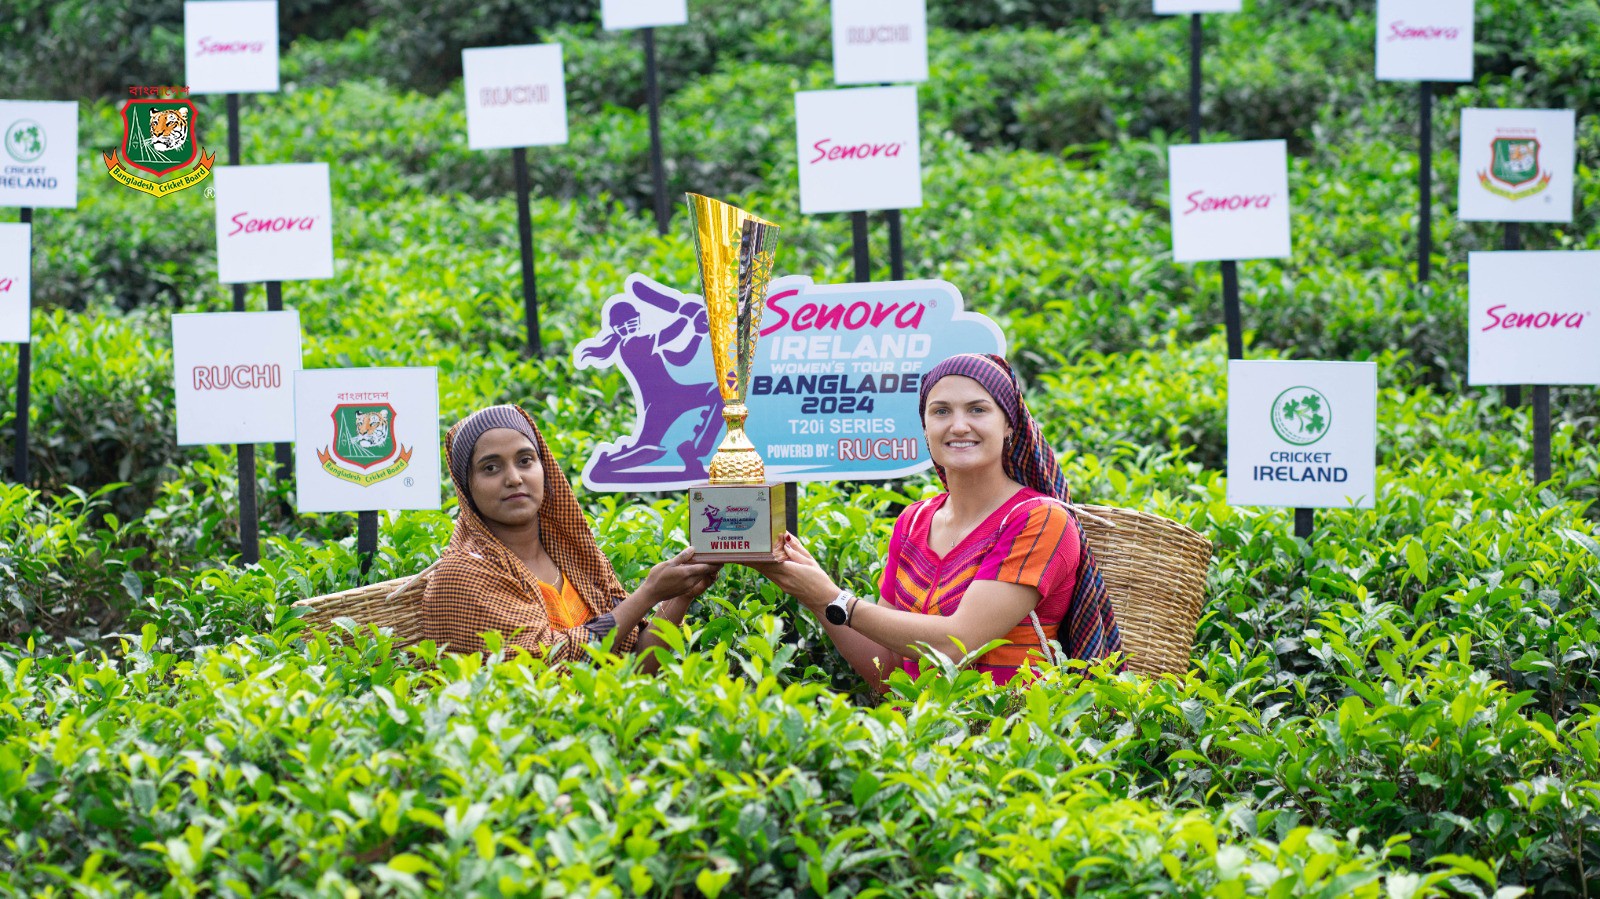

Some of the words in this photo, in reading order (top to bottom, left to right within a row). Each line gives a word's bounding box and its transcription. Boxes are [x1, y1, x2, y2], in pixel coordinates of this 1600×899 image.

[1386, 20, 1459, 41] Senora
[196, 36, 264, 57] Senora
[810, 138, 901, 164] Senora
[1183, 190, 1270, 215] Senora
[227, 212, 314, 237] Senora
[759, 289, 926, 337] Senora
[1482, 304, 1584, 332] Senora
[770, 333, 932, 361] IRELAND
[193, 364, 281, 391] RUCHI
[771, 361, 845, 375] WOMEN'S
[852, 361, 894, 373] TOUR
[900, 361, 923, 372] OF
[752, 373, 925, 395] BANGLADE
[801, 395, 875, 414] 2024
[788, 419, 824, 434] T20i
[829, 418, 896, 434] SERIES
[767, 444, 813, 458] POWERED
[838, 437, 918, 460] RUCHI
[1269, 451, 1331, 464] CRICKET
[326, 462, 361, 481] Bangladesh
[365, 471, 386, 483] Cricket
[386, 461, 405, 474] Board
[1253, 465, 1348, 483] IRELAND
[710, 541, 750, 549] WINNER
